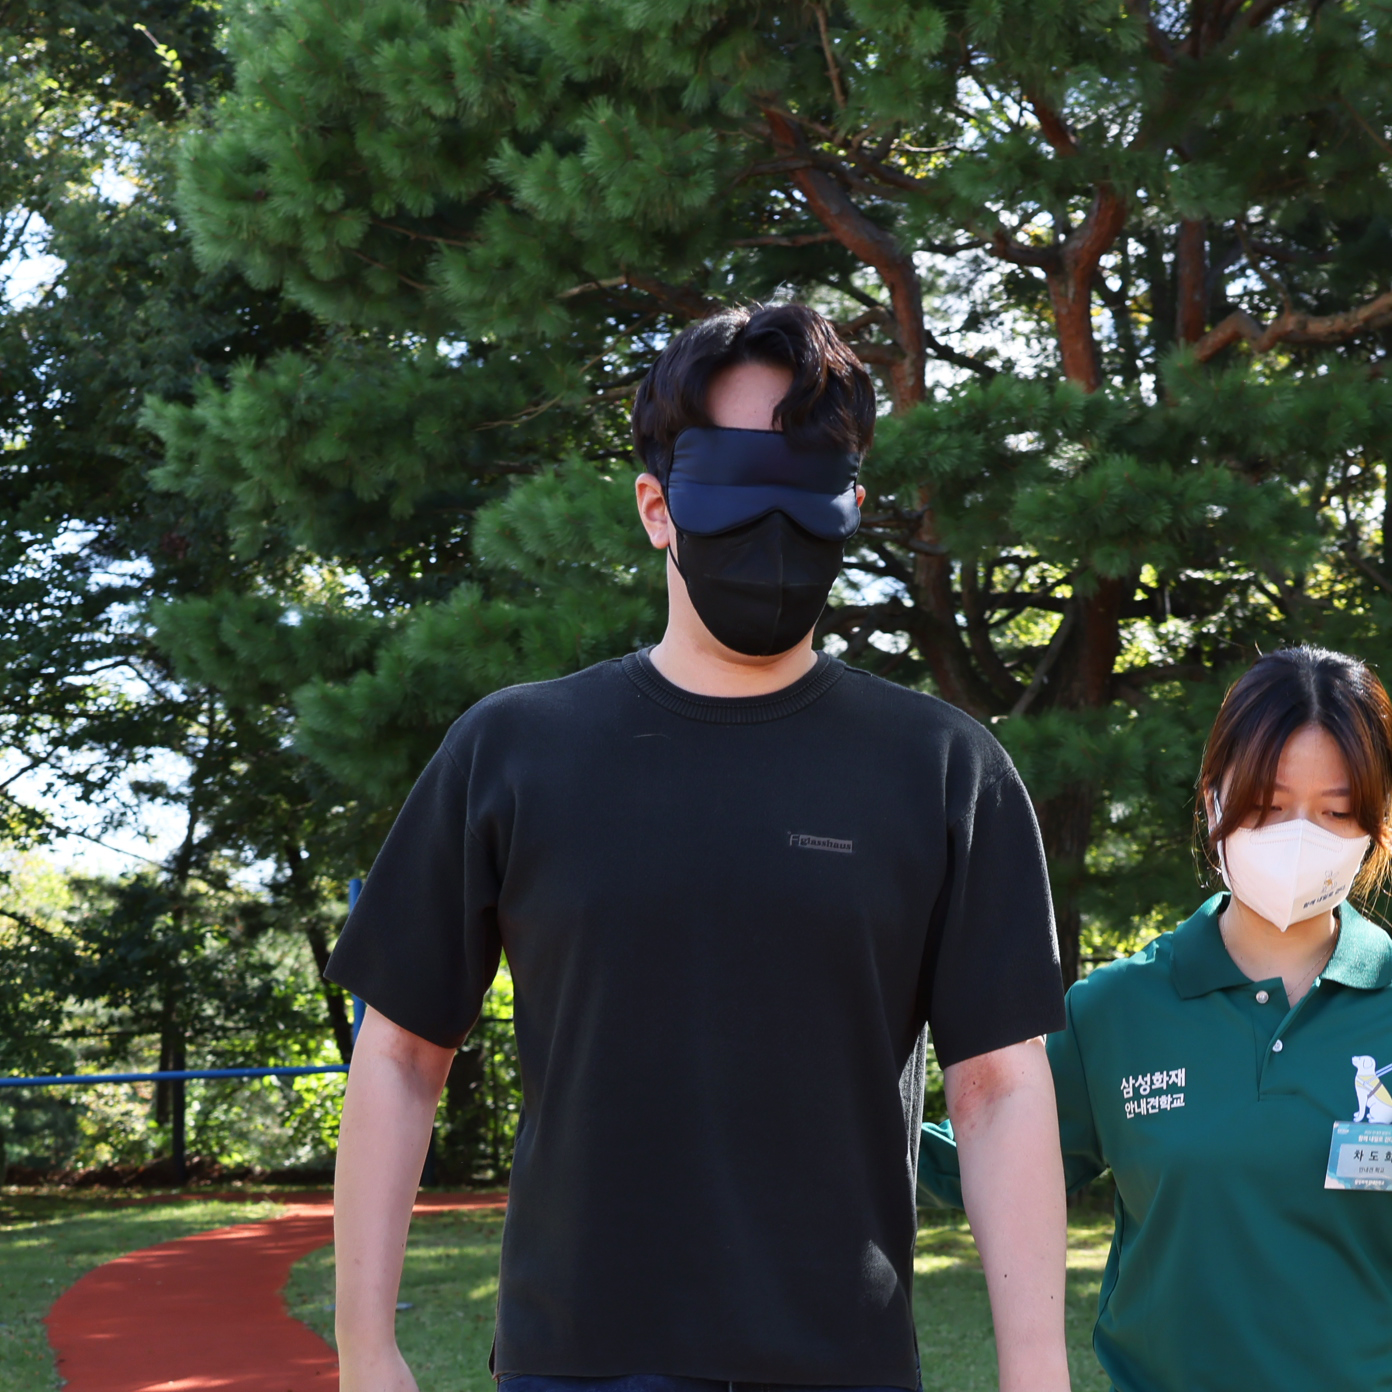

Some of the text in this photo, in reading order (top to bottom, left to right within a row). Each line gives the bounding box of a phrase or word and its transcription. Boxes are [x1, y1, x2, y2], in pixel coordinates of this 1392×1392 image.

[800, 836, 852, 851] glasshaus
[1120, 1067, 1186, 1099] 삼성화재
[1124, 1093, 1185, 1119] 안내견학교
